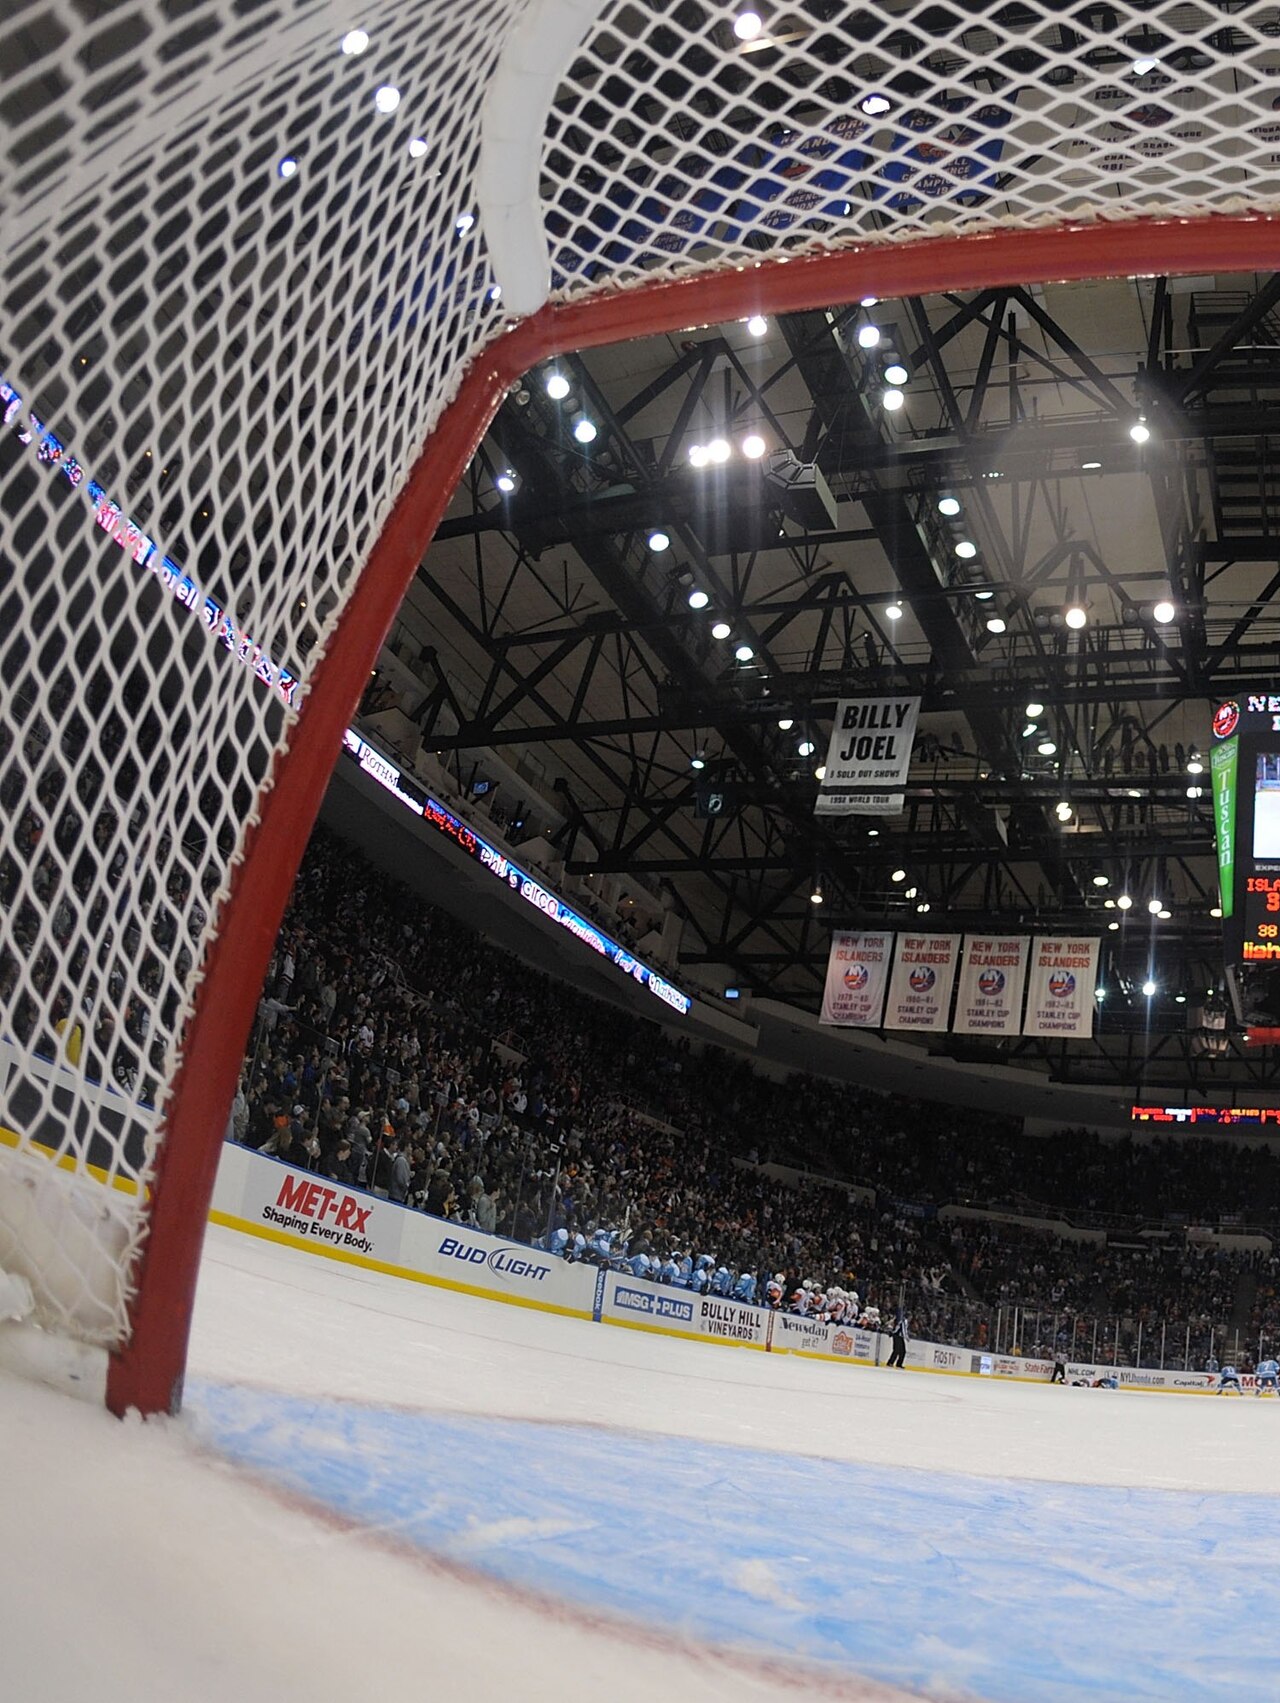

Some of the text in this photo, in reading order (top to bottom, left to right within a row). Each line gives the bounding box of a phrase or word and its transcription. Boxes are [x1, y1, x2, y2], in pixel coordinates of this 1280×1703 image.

[842, 703, 910, 729] BILLY
[840, 736, 897, 761] JOEL
[1218, 768, 1232, 867] Tuscan
[1257, 924, 1278, 938] 38
[840, 936, 885, 948] NEW YORK
[904, 939, 952, 951] NEW YORK
[972, 941, 1020, 952] NEW YORK
[1041, 943, 1090, 954] NEW YORK
[836, 950, 883, 962] ISLANDERS
[901, 952, 951, 964] ISLANDERS
[969, 955, 1019, 967] ISLANDERS
[1039, 956, 1090, 968] ISLANDERS
[897, 1006, 924, 1014] STANLEY
[967, 1009, 994, 1017] STANLEY
[1037, 1011, 1065, 1019] STANLEY
[262, 1206, 309, 1234] Shaping
[310, 1222, 343, 1244] Every
[438, 1238, 551, 1281] BUD LIGHT
[622, 1291, 691, 1319] MSG PLUS
[701, 1301, 737, 1323] BULLY
[739, 1310, 761, 1328] HILL
[708, 1319, 753, 1341] VINEYARDS
[780, 1317, 829, 1341] Newsday
